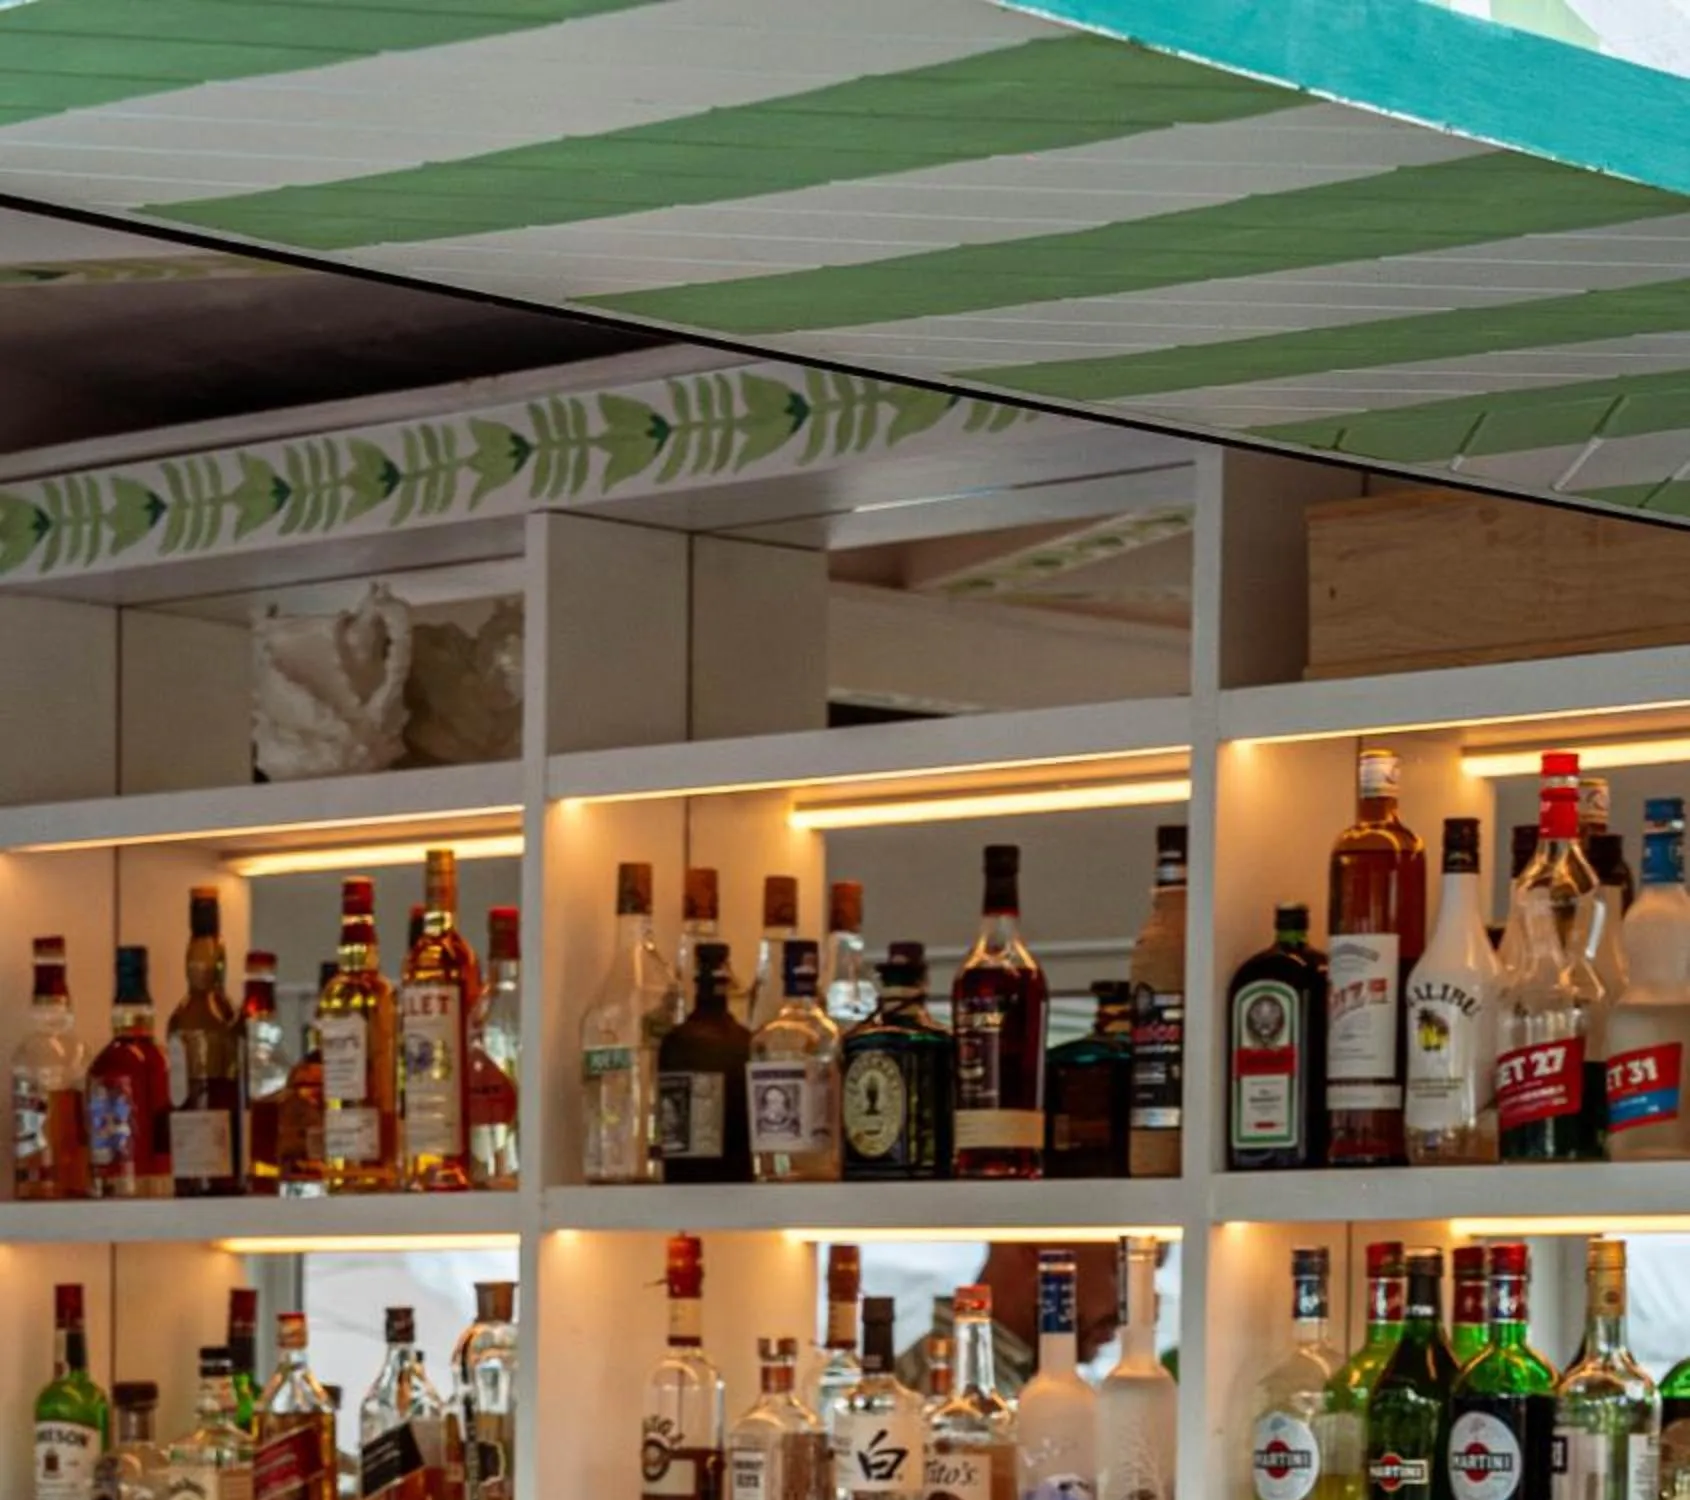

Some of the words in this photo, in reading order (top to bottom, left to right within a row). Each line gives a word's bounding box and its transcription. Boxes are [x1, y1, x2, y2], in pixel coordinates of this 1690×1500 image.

[1408, 982, 1481, 1016] ALIBU
[1497, 1056, 1525, 1088] ET
[1529, 1046, 1567, 1077] 27
[1606, 1064, 1623, 1091] ET
[1626, 1056, 1659, 1084] 31
[857, 1429, 909, 1482] 白
[1255, 1451, 1311, 1468] MARTINI
[1369, 1464, 1423, 1479] MARTINI
[1453, 1453, 1512, 1470] MARTINI
